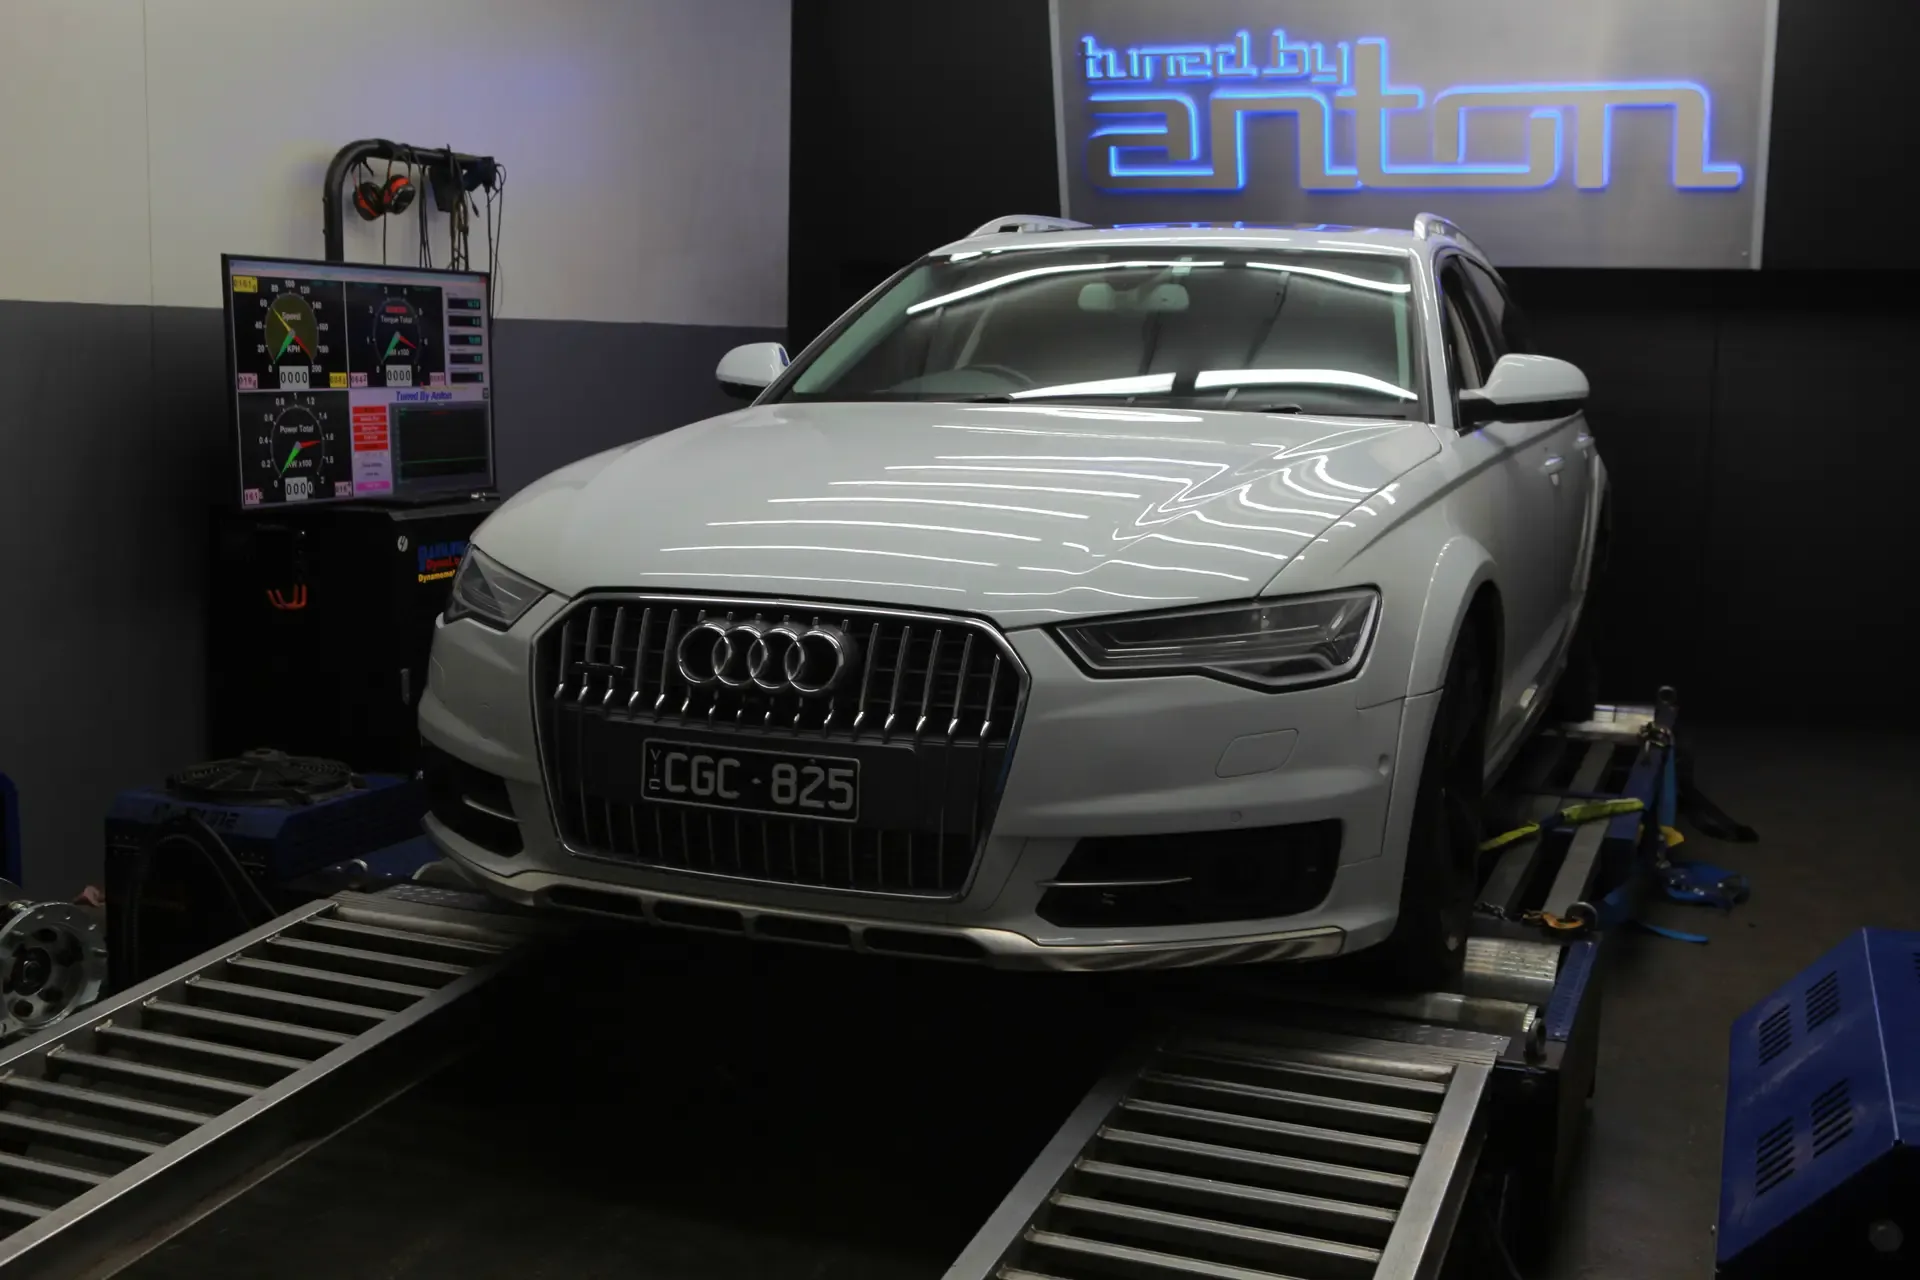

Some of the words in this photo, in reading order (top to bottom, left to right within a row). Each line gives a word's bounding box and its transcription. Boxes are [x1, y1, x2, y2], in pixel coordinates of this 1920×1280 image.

[1262, 28, 1351, 86] by
[1086, 36, 1745, 191] anton
[287, 345, 300, 353] KPH
[280, 371, 308, 384] 0000
[387, 370, 411, 380] 0000
[396, 391, 418, 401] Tuned
[420, 391, 430, 402] By
[431, 390, 452, 400] Anton
[286, 482, 313, 495] 0000
[649, 748, 662, 790] VIC
[665, 752, 741, 799] CGC
[771, 763, 854, 811] 825
